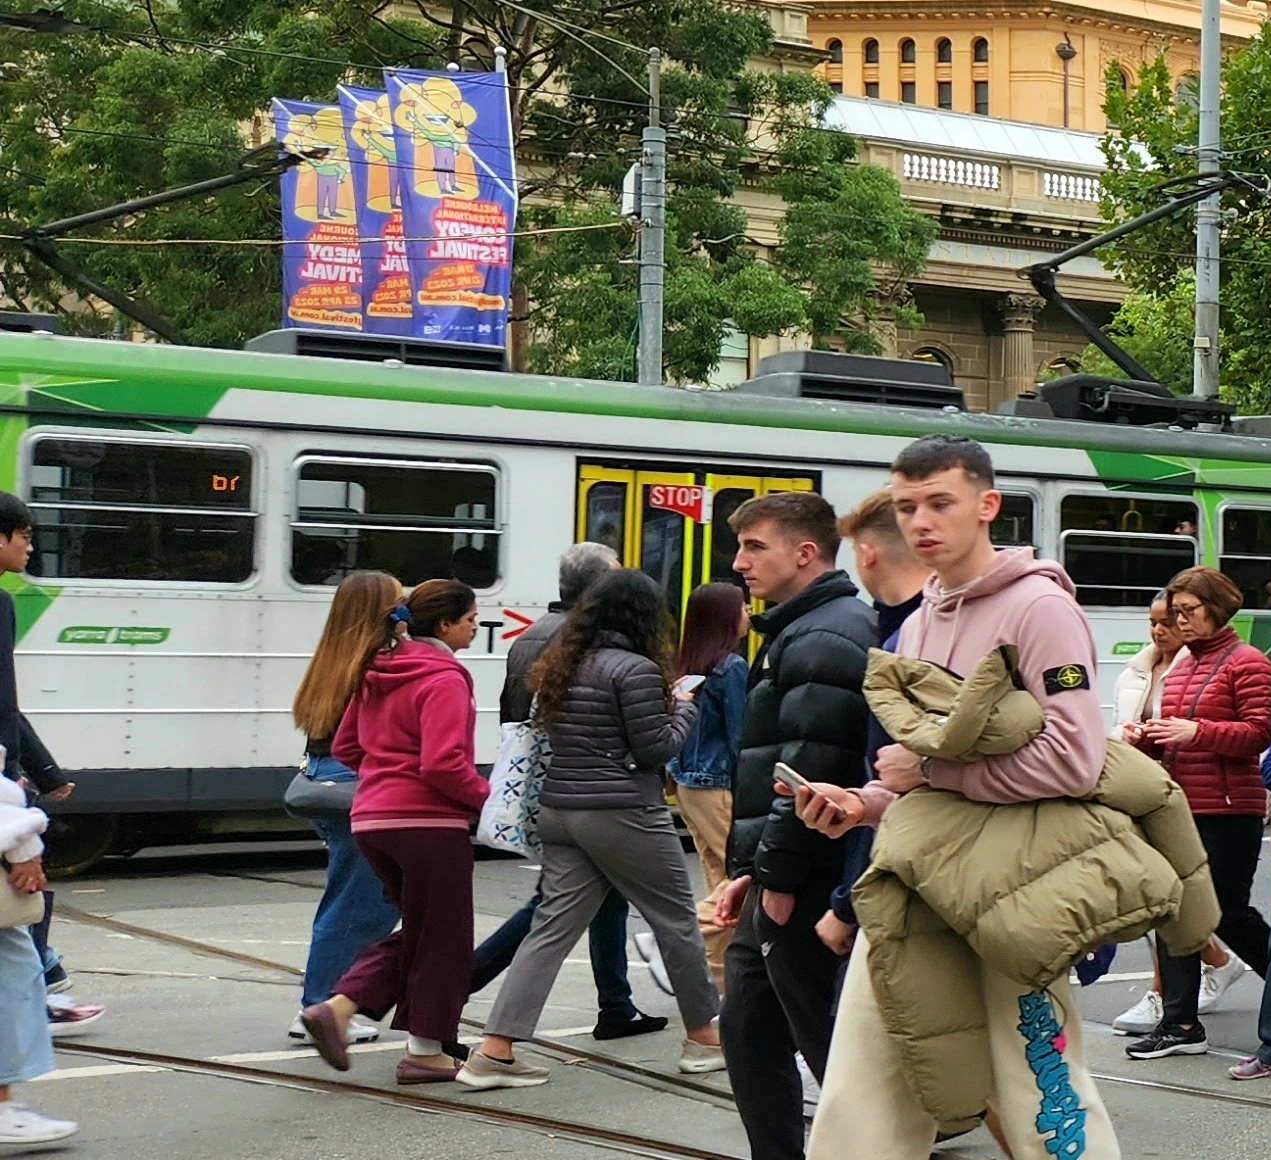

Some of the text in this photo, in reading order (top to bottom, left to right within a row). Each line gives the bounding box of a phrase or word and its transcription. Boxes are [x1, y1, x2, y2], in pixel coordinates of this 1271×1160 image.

[651, 486, 701, 506] STOP
[65, 629, 163, 641] yarra trams
